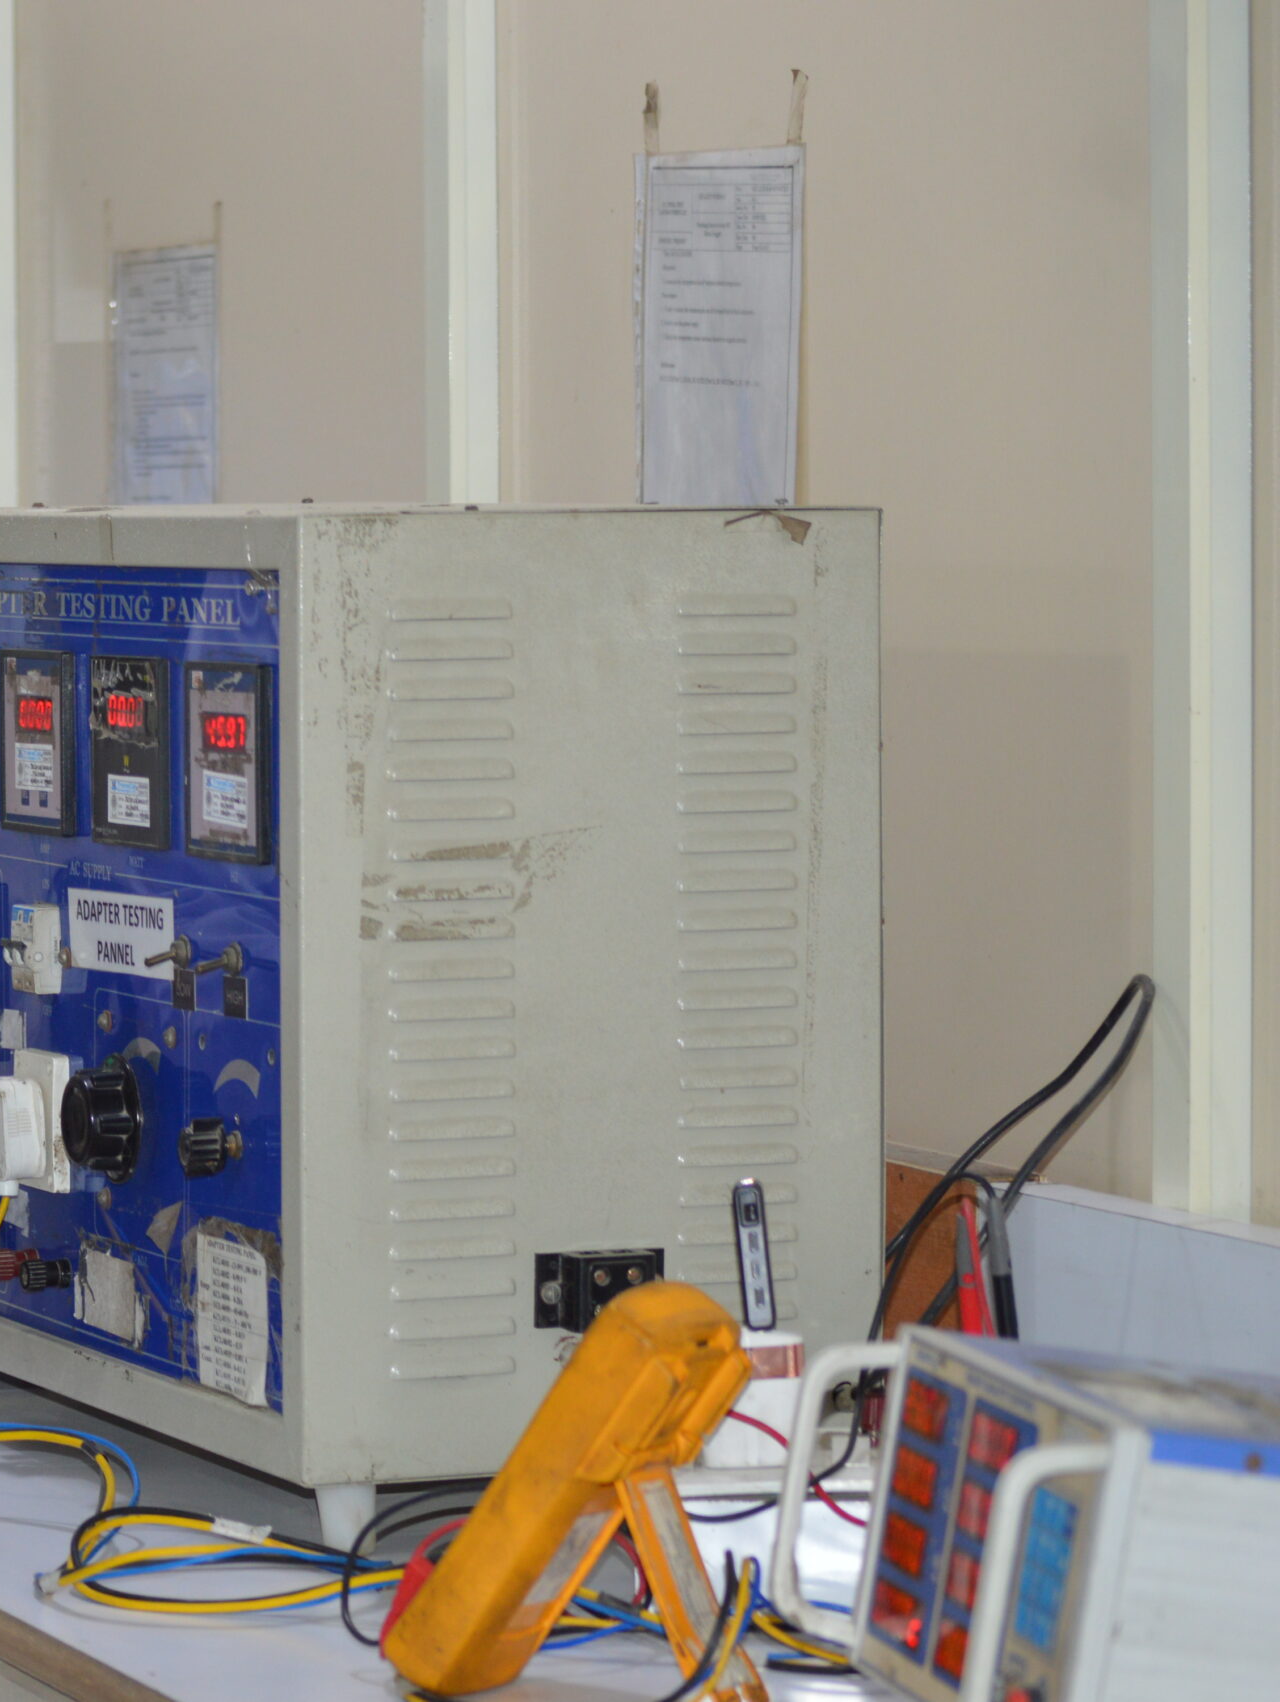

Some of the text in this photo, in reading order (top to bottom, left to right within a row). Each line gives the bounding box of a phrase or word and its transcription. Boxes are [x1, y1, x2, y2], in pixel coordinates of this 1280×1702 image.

[56, 591, 152, 622] TESTING
[160, 596, 241, 626] PANEL
[69, 860, 112, 881] AC SUPPLY
[76, 899, 164, 930] ADAPTER TESTING
[97, 940, 135, 966] PANNEL
[226, 990, 244, 1005] HIGH
